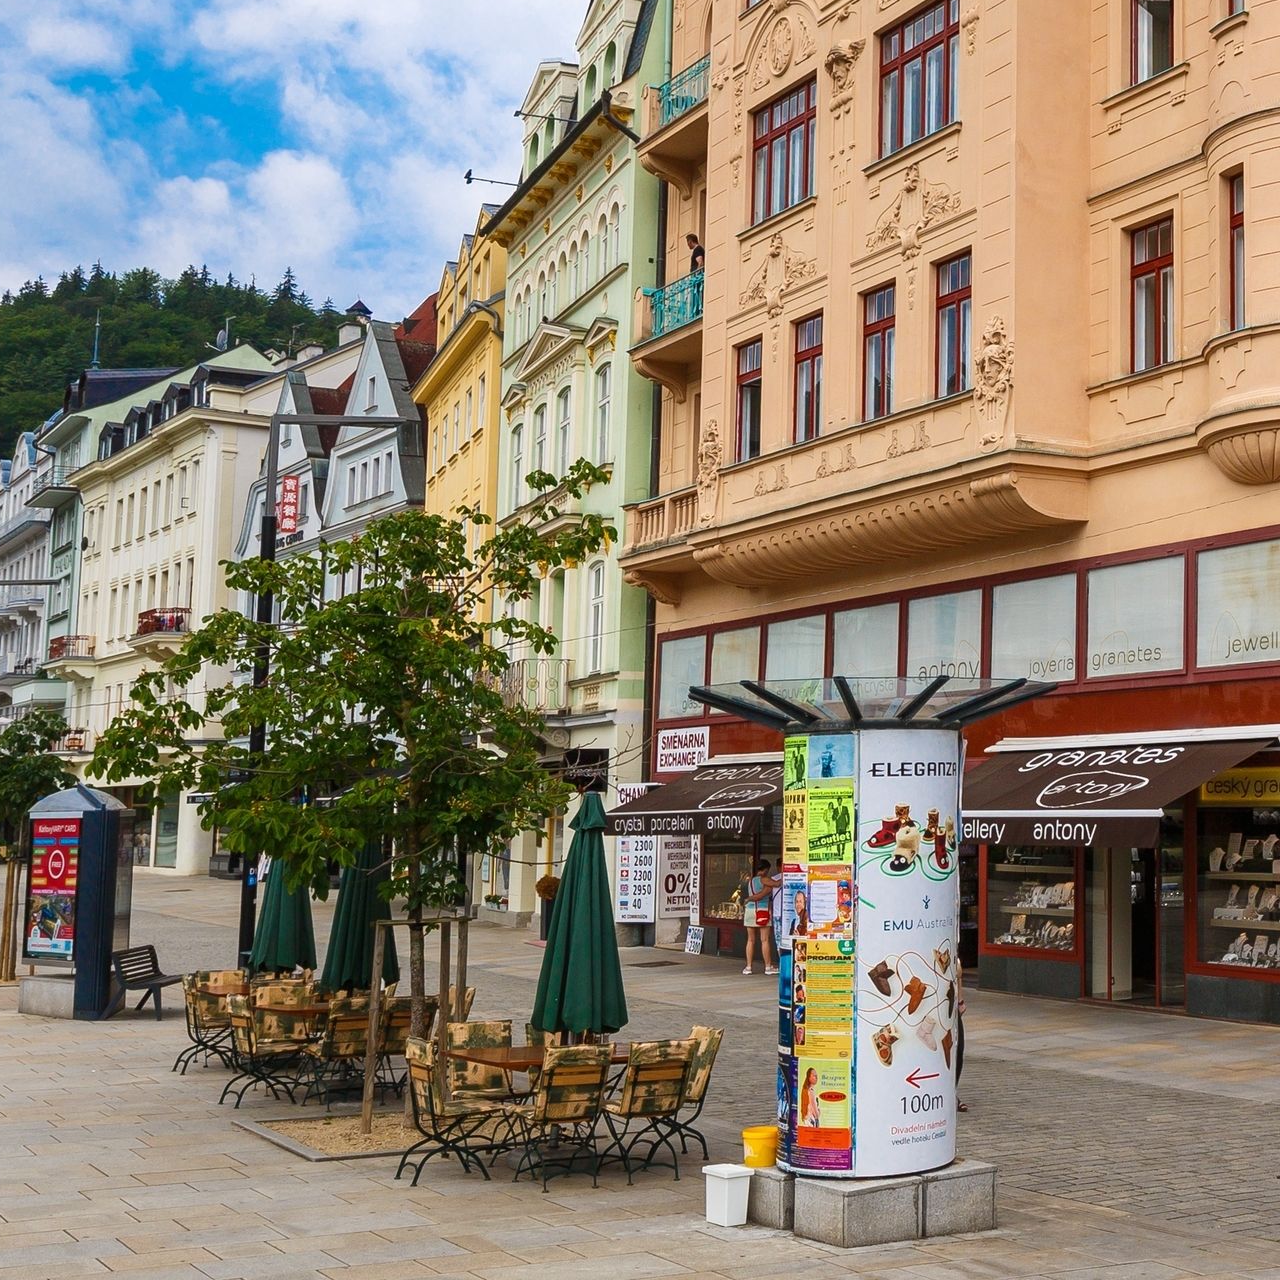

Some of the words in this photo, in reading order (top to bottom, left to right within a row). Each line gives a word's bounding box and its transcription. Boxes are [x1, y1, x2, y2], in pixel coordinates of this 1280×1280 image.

[1092, 645, 1162, 671] granates
[918, 658, 980, 684] antony
[661, 731, 706, 751] SMĚNÁRNA
[659, 751, 696, 768] EXCHANGE
[1017, 745, 1185, 773] granates
[867, 761, 957, 778] ELEGANZA
[614, 816, 645, 836] crystal
[650, 815, 694, 834] porcelain
[706, 812, 745, 834] antony
[961, 819, 1006, 845] ellery
[1033, 820, 1097, 847] antony
[634, 840, 653, 852] 2300
[634, 855, 653, 867] 2600
[633, 870, 652, 881] 2300
[632, 884, 652, 896] 2950
[632, 898, 642, 910] 40
[666, 895, 691, 905] NETTO
[883, 919, 914, 932] EMU
[900, 1093, 944, 1115] 100m
[890, 1122, 926, 1136] Divadelní
[891, 1136, 911, 1146] vedle
